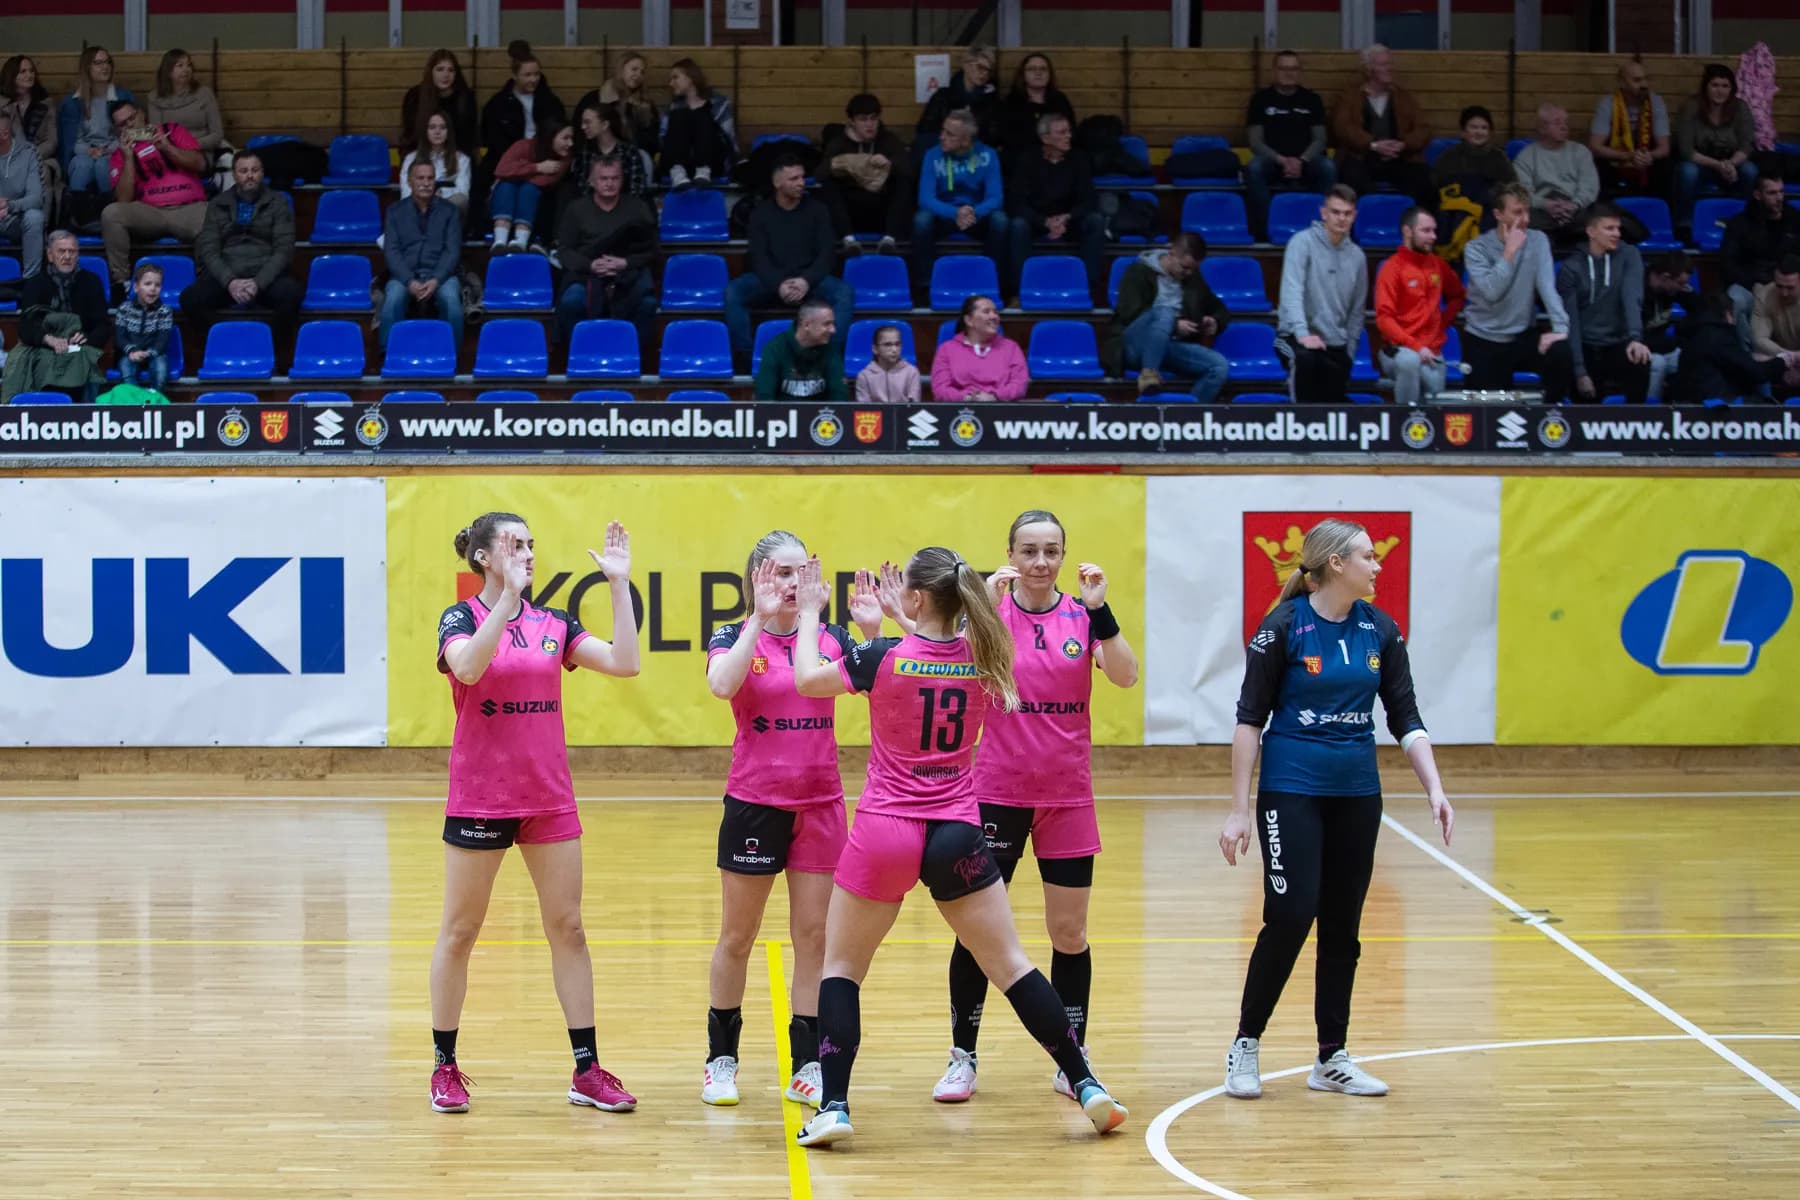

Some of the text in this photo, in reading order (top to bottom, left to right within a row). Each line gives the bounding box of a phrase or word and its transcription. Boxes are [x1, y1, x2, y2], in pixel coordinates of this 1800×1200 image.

[400, 408, 798, 447] www.koronahandball.pl
[994, 411, 1390, 450] www.koronahandball.pl
[1034, 623, 1047, 650] 2
[1338, 638, 1350, 665] 1
[919, 663, 977, 676] LEWIATA
[502, 701, 558, 714] SUZUKI
[918, 687, 968, 752] 13
[1018, 701, 1085, 714] SUZUKI
[1319, 711, 1371, 725] SUZUK
